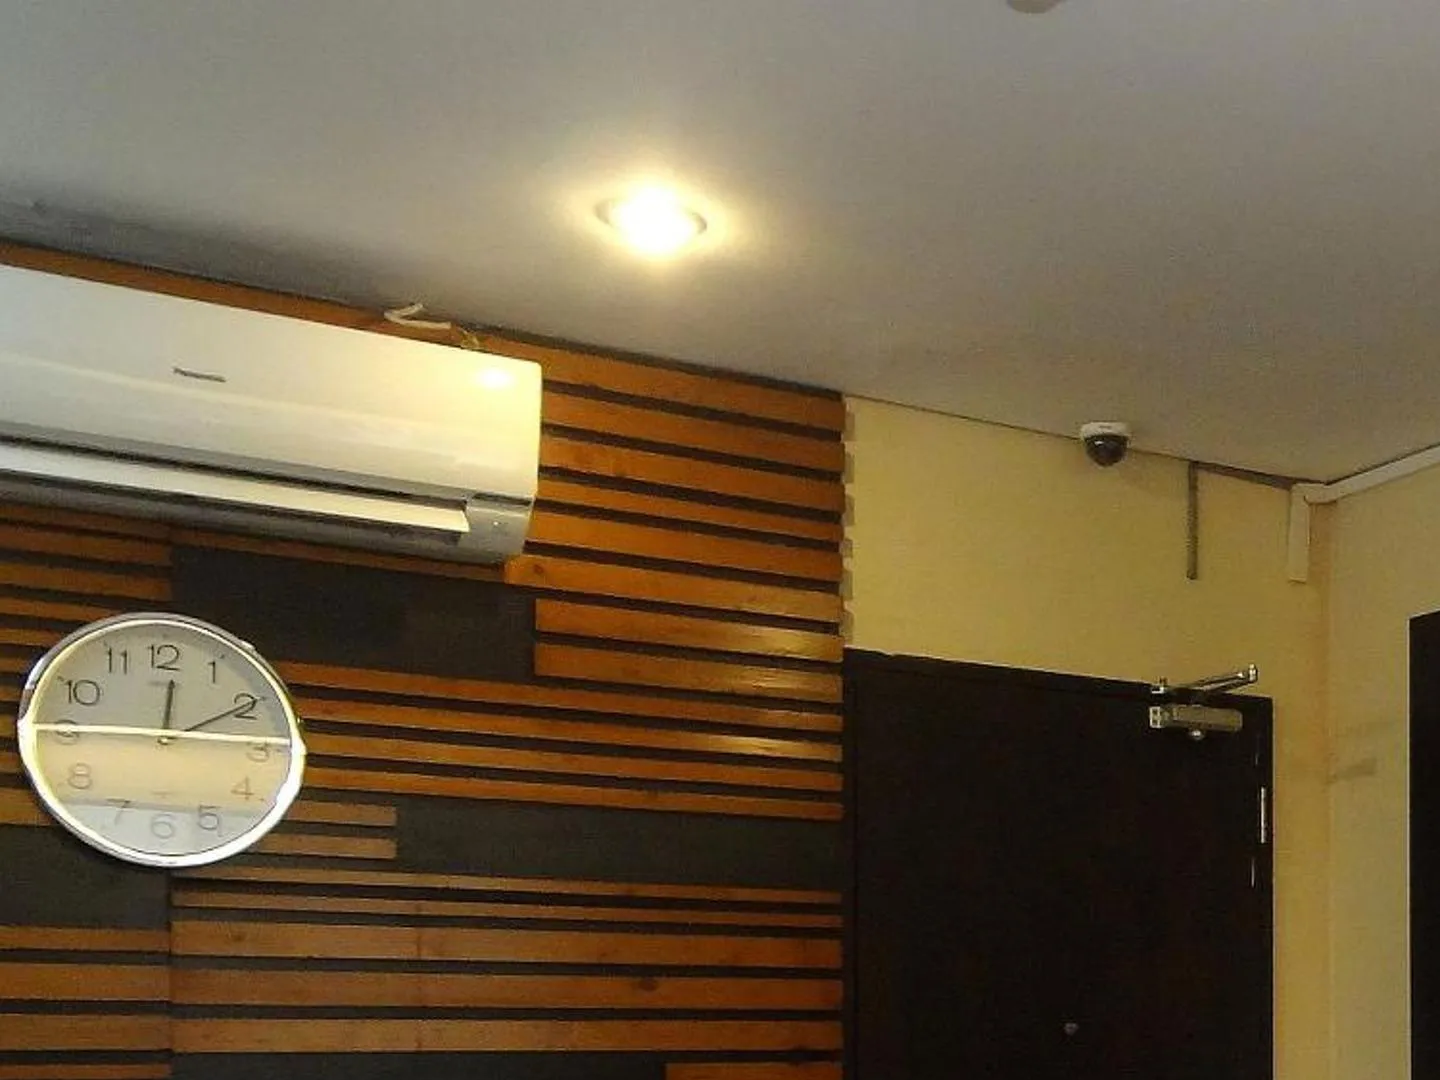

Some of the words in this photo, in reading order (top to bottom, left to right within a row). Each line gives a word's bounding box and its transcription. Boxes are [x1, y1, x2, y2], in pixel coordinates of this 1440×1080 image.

[106, 648, 129, 675] 11
[148, 644, 181, 671] 12
[207, 661, 218, 684] 1
[65, 679, 101, 706] 10
[233, 693, 259, 720] 2
[67, 763, 93, 790] 8
[230, 776, 255, 800] 4
[106, 799, 132, 825] 7
[197, 805, 222, 832] 5
[150, 814, 177, 839] 6
